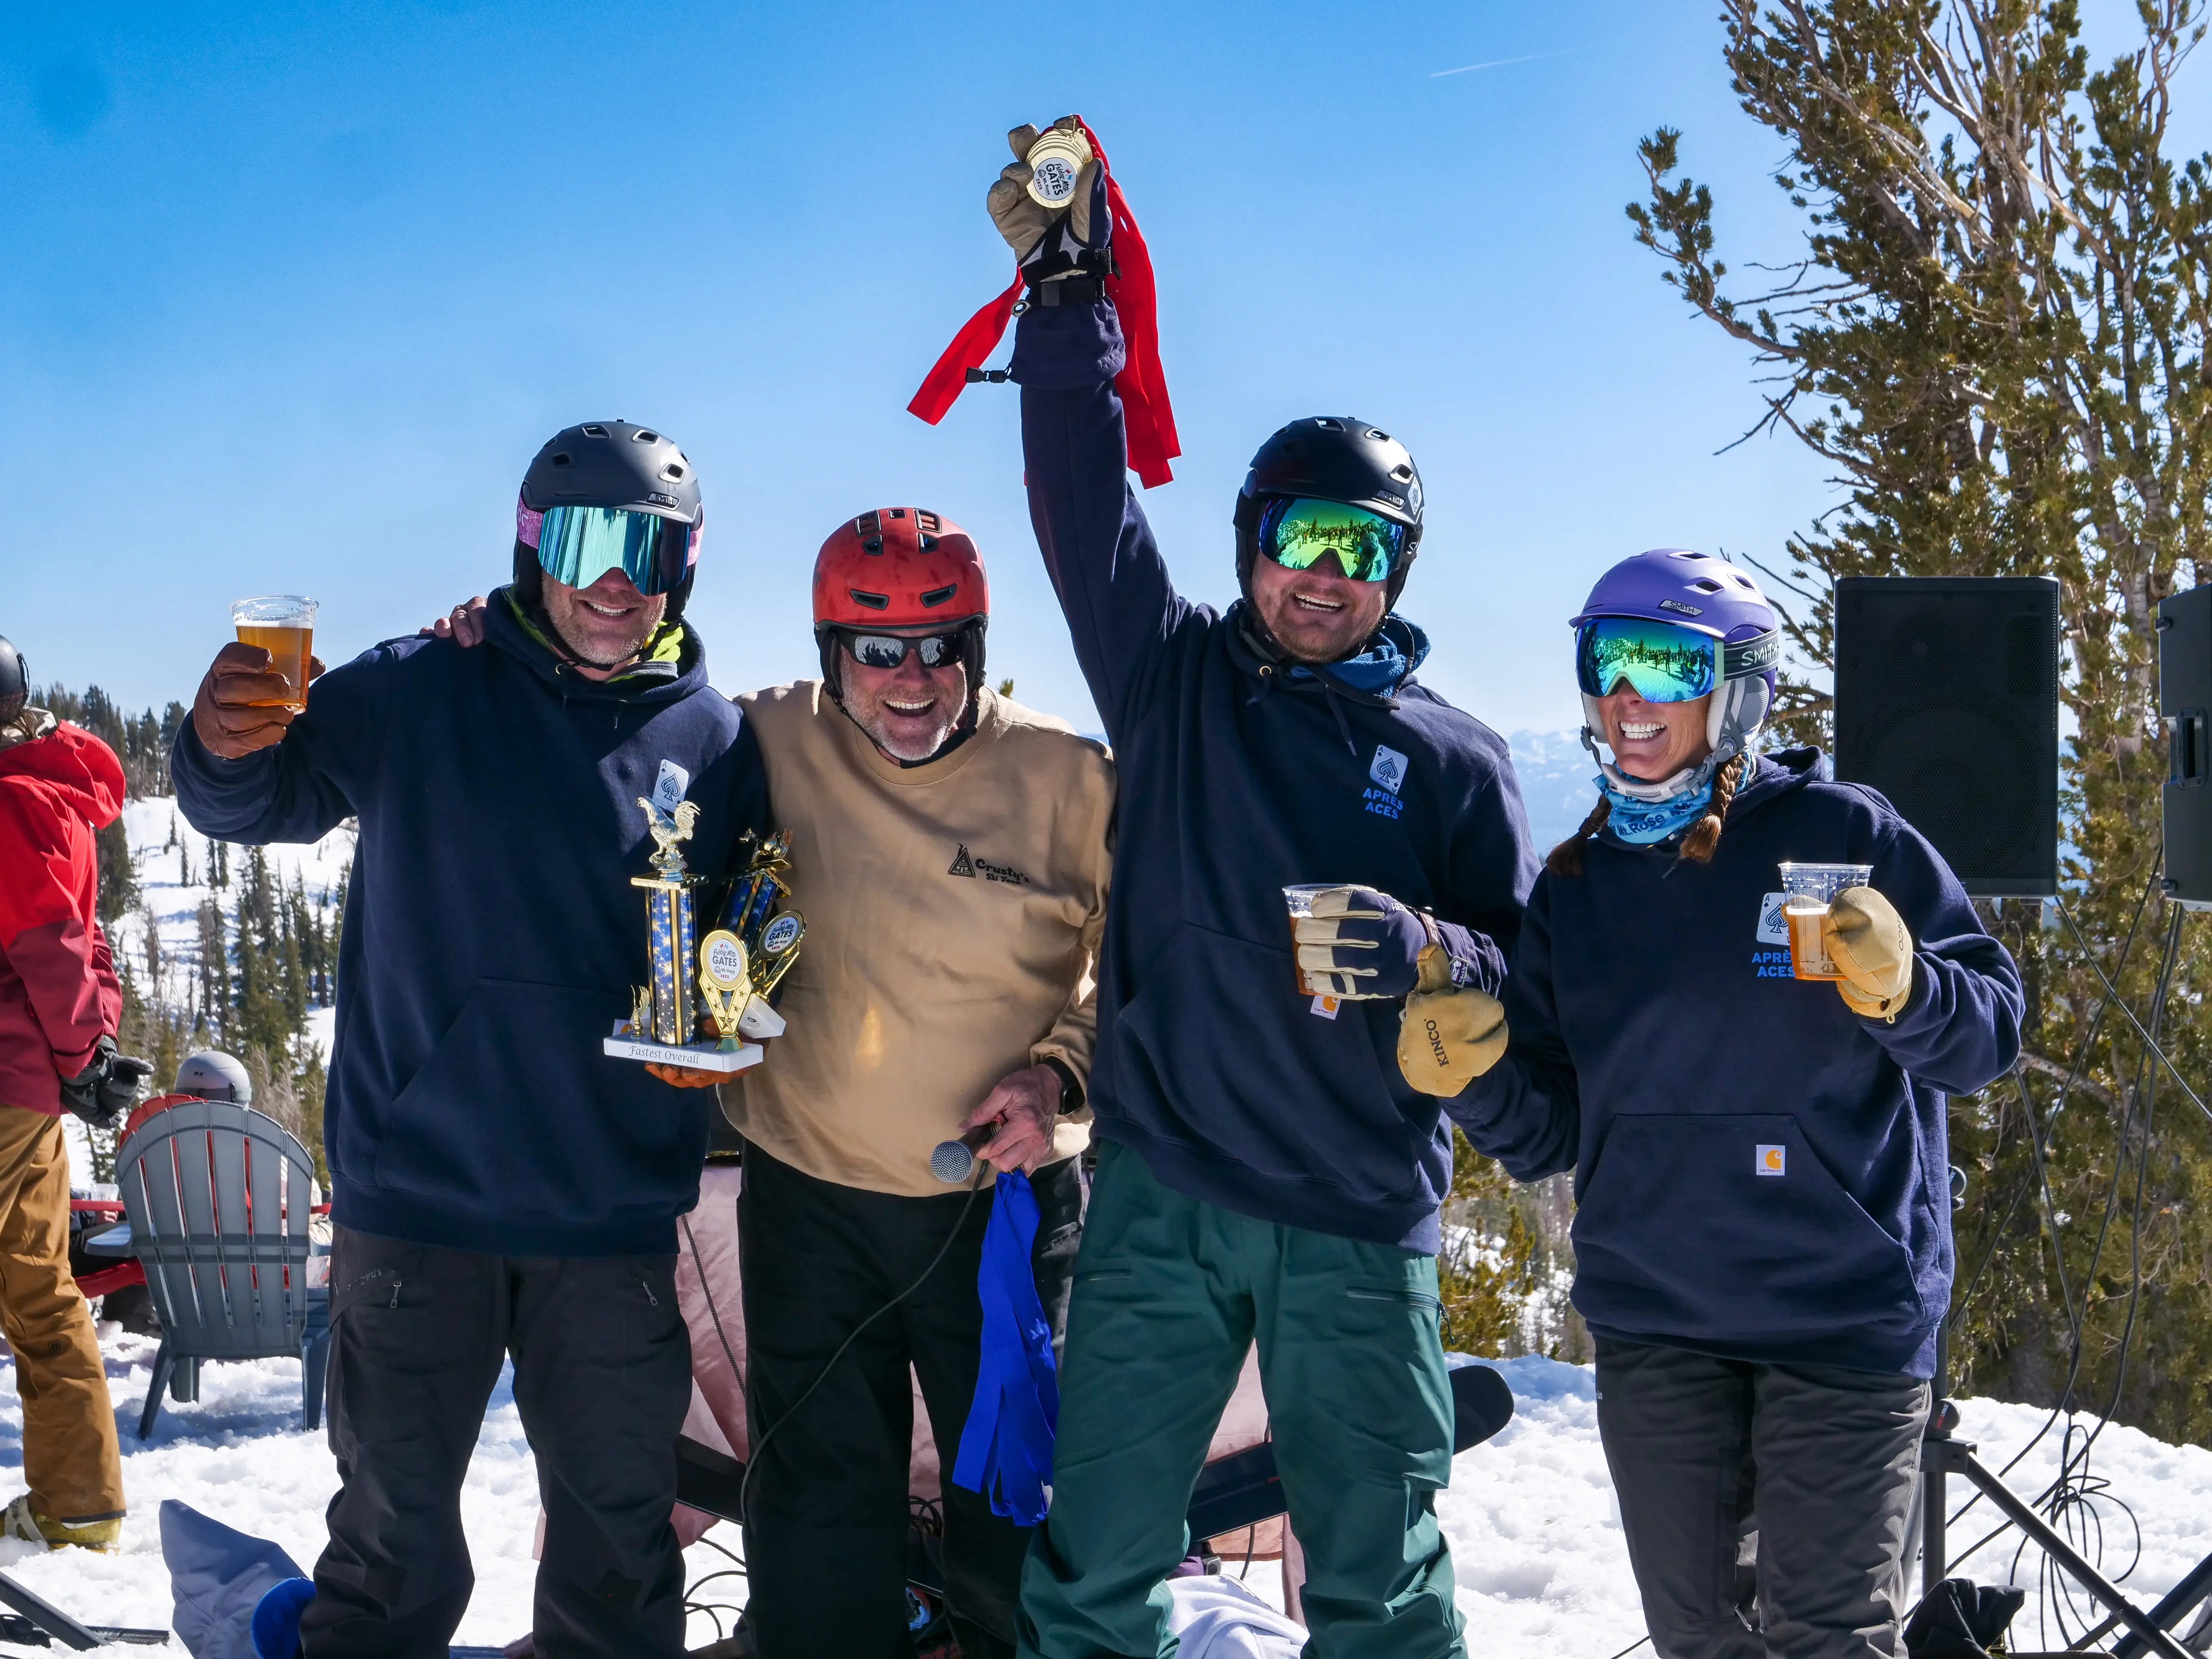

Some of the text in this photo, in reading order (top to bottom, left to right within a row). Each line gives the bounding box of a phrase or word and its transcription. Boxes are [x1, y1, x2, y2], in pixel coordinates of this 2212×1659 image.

[1054, 163, 1065, 180] Friday
[1046, 163, 1063, 195] GATES
[655, 495, 673, 505] SMITH
[1384, 492, 1400, 504] SMITH
[1670, 601, 1694, 614] SMITH
[1741, 640, 1779, 666] SMITH
[1365, 801, 1398, 819] ACES
[1628, 814, 1665, 833] Rose
[975, 858, 1030, 883] Crusty's
[986, 873, 998, 881] Ski
[768, 929, 793, 940] GATES
[713, 949, 736, 958] Friday Nite
[1752, 949, 1792, 963] APRÈ
[713, 956, 737, 967] GATES
[1757, 966, 1796, 977] ACES
[1426, 1019, 1449, 1067] KINCO
[629, 1045, 701, 1064] Fastest Overall
